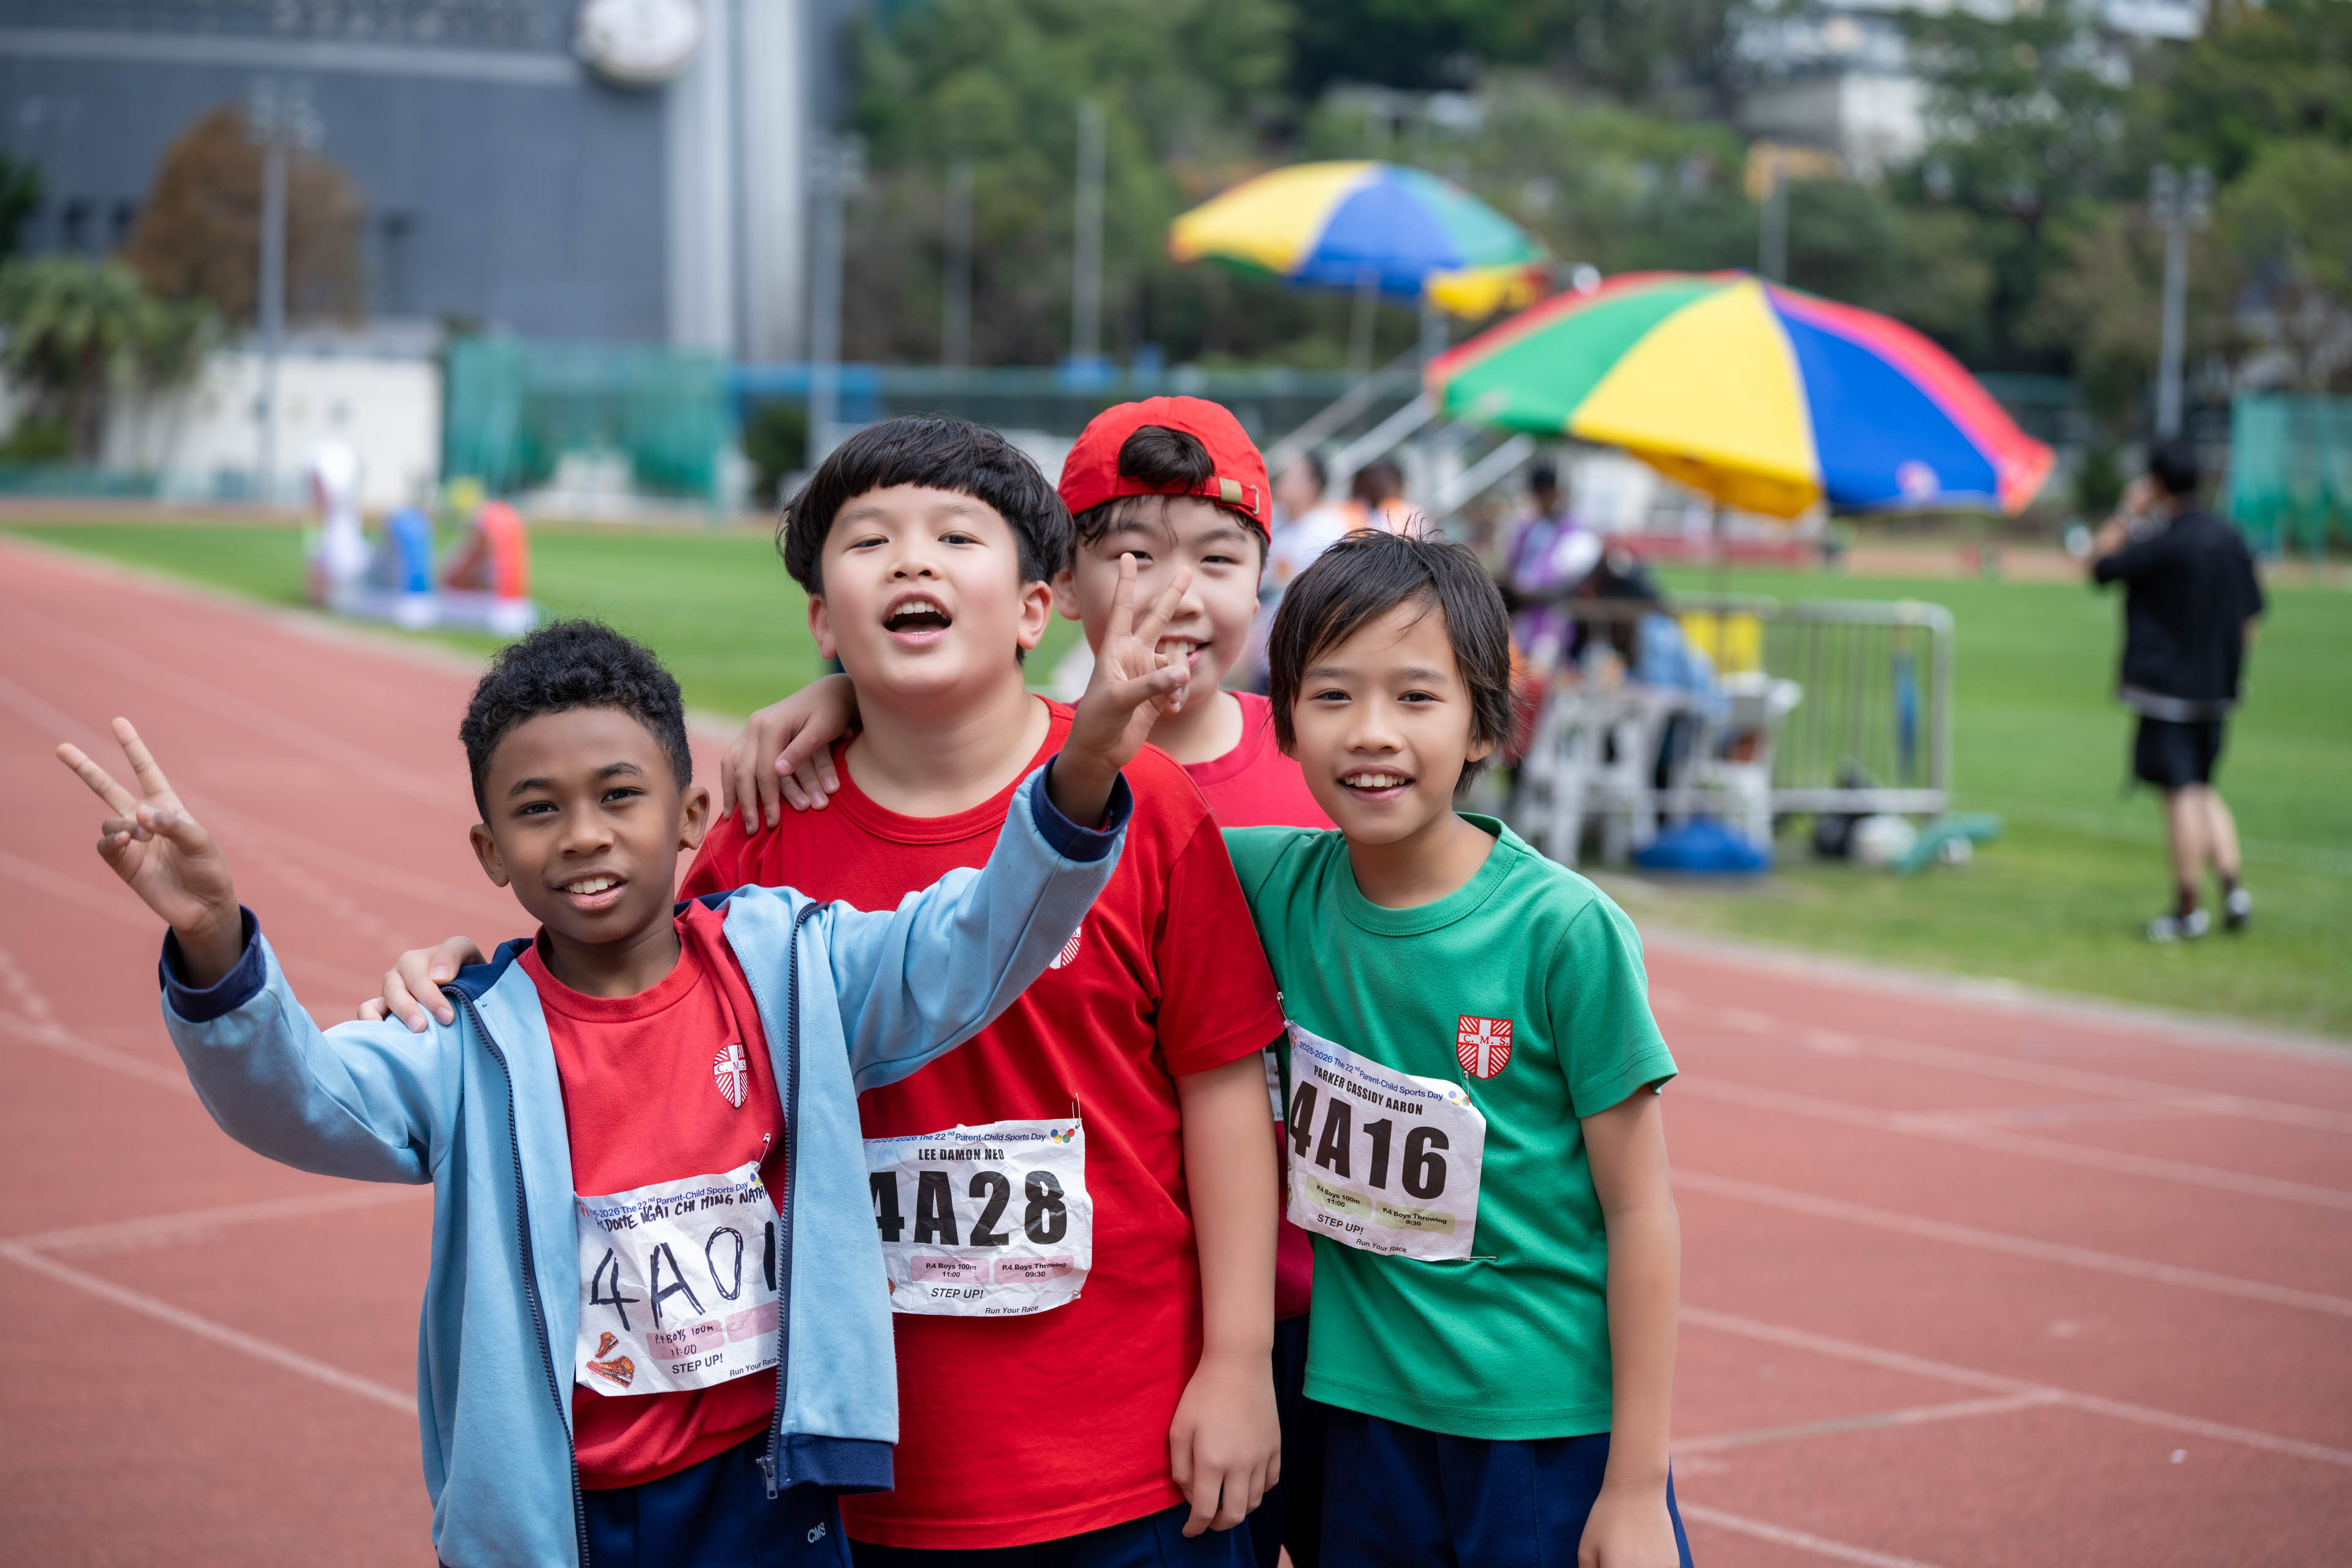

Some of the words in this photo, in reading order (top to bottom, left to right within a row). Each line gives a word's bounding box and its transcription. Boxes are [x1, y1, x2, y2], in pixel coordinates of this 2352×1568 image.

[1299, 1041, 1333, 1063] 2025-2026
[1334, 1057, 1345, 1069] The
[1360, 1070, 1398, 1091] Parent-Child
[1399, 1086, 1426, 1097] Sports
[1427, 1091, 1444, 1101] Day
[1314, 1065, 1346, 1089] PARKER
[1346, 1080, 1384, 1106] CASSIDY
[1385, 1097, 1423, 1115] AARON
[1005, 1133, 1030, 1142] Sports
[1031, 1133, 1047, 1142] Day
[1289, 1080, 1450, 1200] 4A16
[918, 1148, 937, 1161] LEE
[940, 1148, 981, 1161] DAMON
[984, 1148, 1005, 1160] NEO
[593, 1207, 620, 1218] 5-2026
[620, 1205, 636, 1215] The
[657, 1188, 704, 1205] Parent-Child
[706, 1186, 734, 1195] Sports
[736, 1182, 748, 1191] Day
[640, 1205, 669, 1224] NGAI
[674, 1199, 695, 1215] CHI
[701, 1194, 734, 1211] MING
[739, 1185, 767, 1204] NATH
[1324, 1189, 1340, 1199] Boys
[1341, 1194, 1360, 1205] 100m
[1327, 1198, 1345, 1208] 11:00
[869, 1170, 1067, 1246] 4A28
[1393, 1211, 1411, 1219] Boys
[1412, 1213, 1447, 1224] Throwing
[1317, 1214, 1343, 1228] STEP
[1345, 1223, 1364, 1235] UP!
[1356, 1238, 1370, 1247] Run
[1372, 1242, 1388, 1252] Your
[589, 1220, 777, 1332] 4A01
[930, 1287, 960, 1298] STEP
[963, 1289, 984, 1299] UP!
[671, 1344, 697, 1357] 11:00
[672, 1359, 702, 1374] STEP
[705, 1352, 723, 1367] UP!
[729, 1368, 744, 1377] Run
[745, 1363, 761, 1373] Your
[763, 1357, 777, 1366] Race
[807, 1521, 826, 1544] CMS
